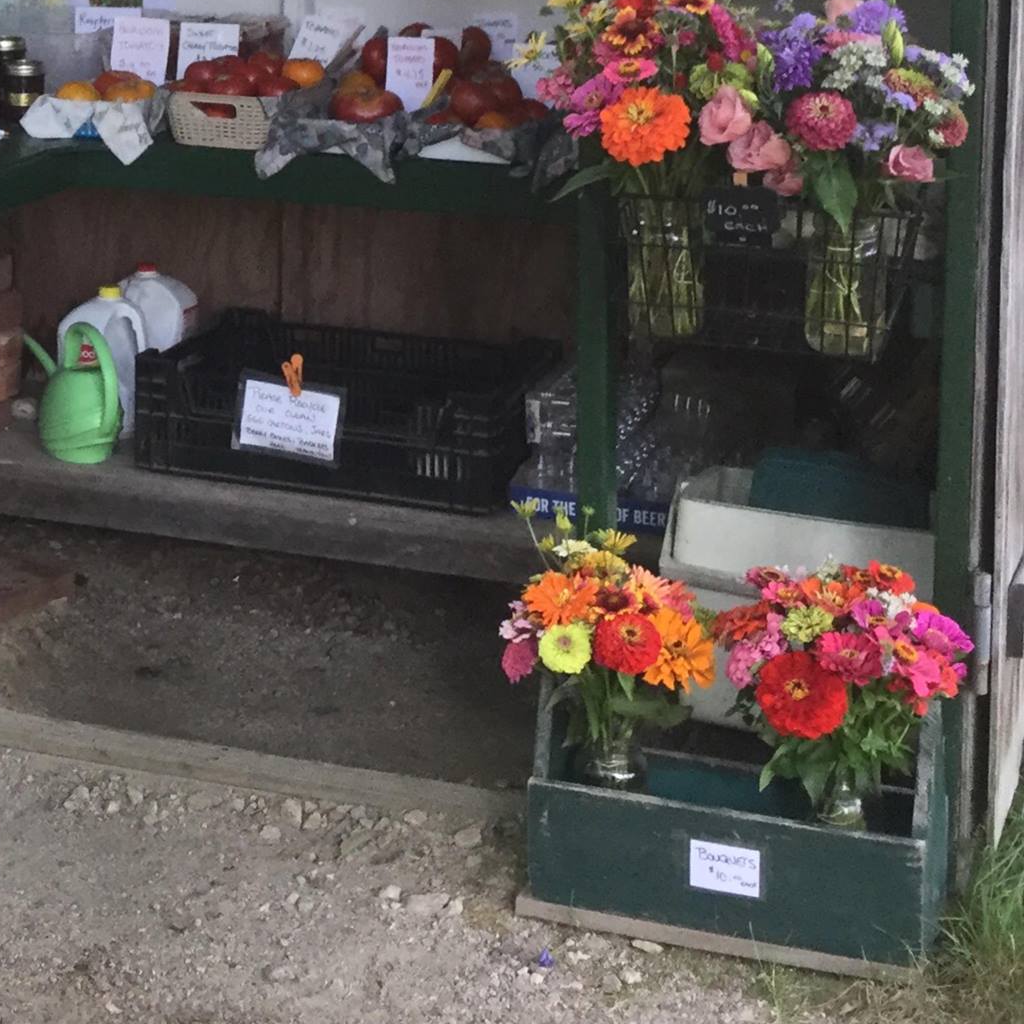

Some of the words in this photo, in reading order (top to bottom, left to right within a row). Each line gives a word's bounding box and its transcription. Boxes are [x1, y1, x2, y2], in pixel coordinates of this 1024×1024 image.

[526, 496, 549, 513] FOR
[552, 499, 576, 518] THE
[616, 507, 630, 523] OF
[633, 509, 667, 526] BEER
